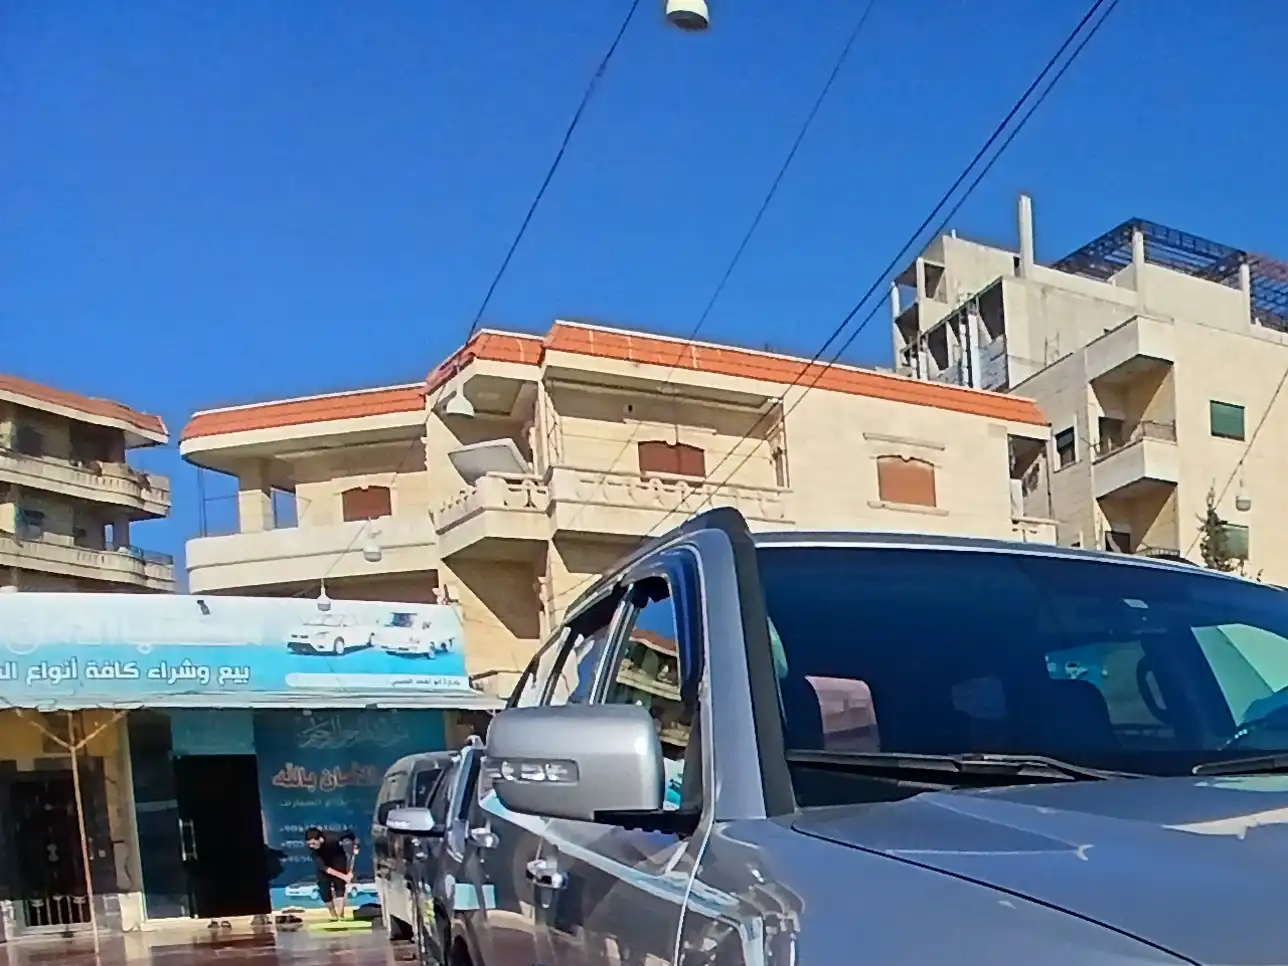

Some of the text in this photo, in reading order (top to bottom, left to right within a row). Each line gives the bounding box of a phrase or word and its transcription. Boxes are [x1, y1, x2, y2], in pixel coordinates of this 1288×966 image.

[25, 656, 79, 686] أنواع
[85, 660, 140, 680] كافة
[147, 658, 210, 685] وشراء
[218, 665, 250, 685] بيع
